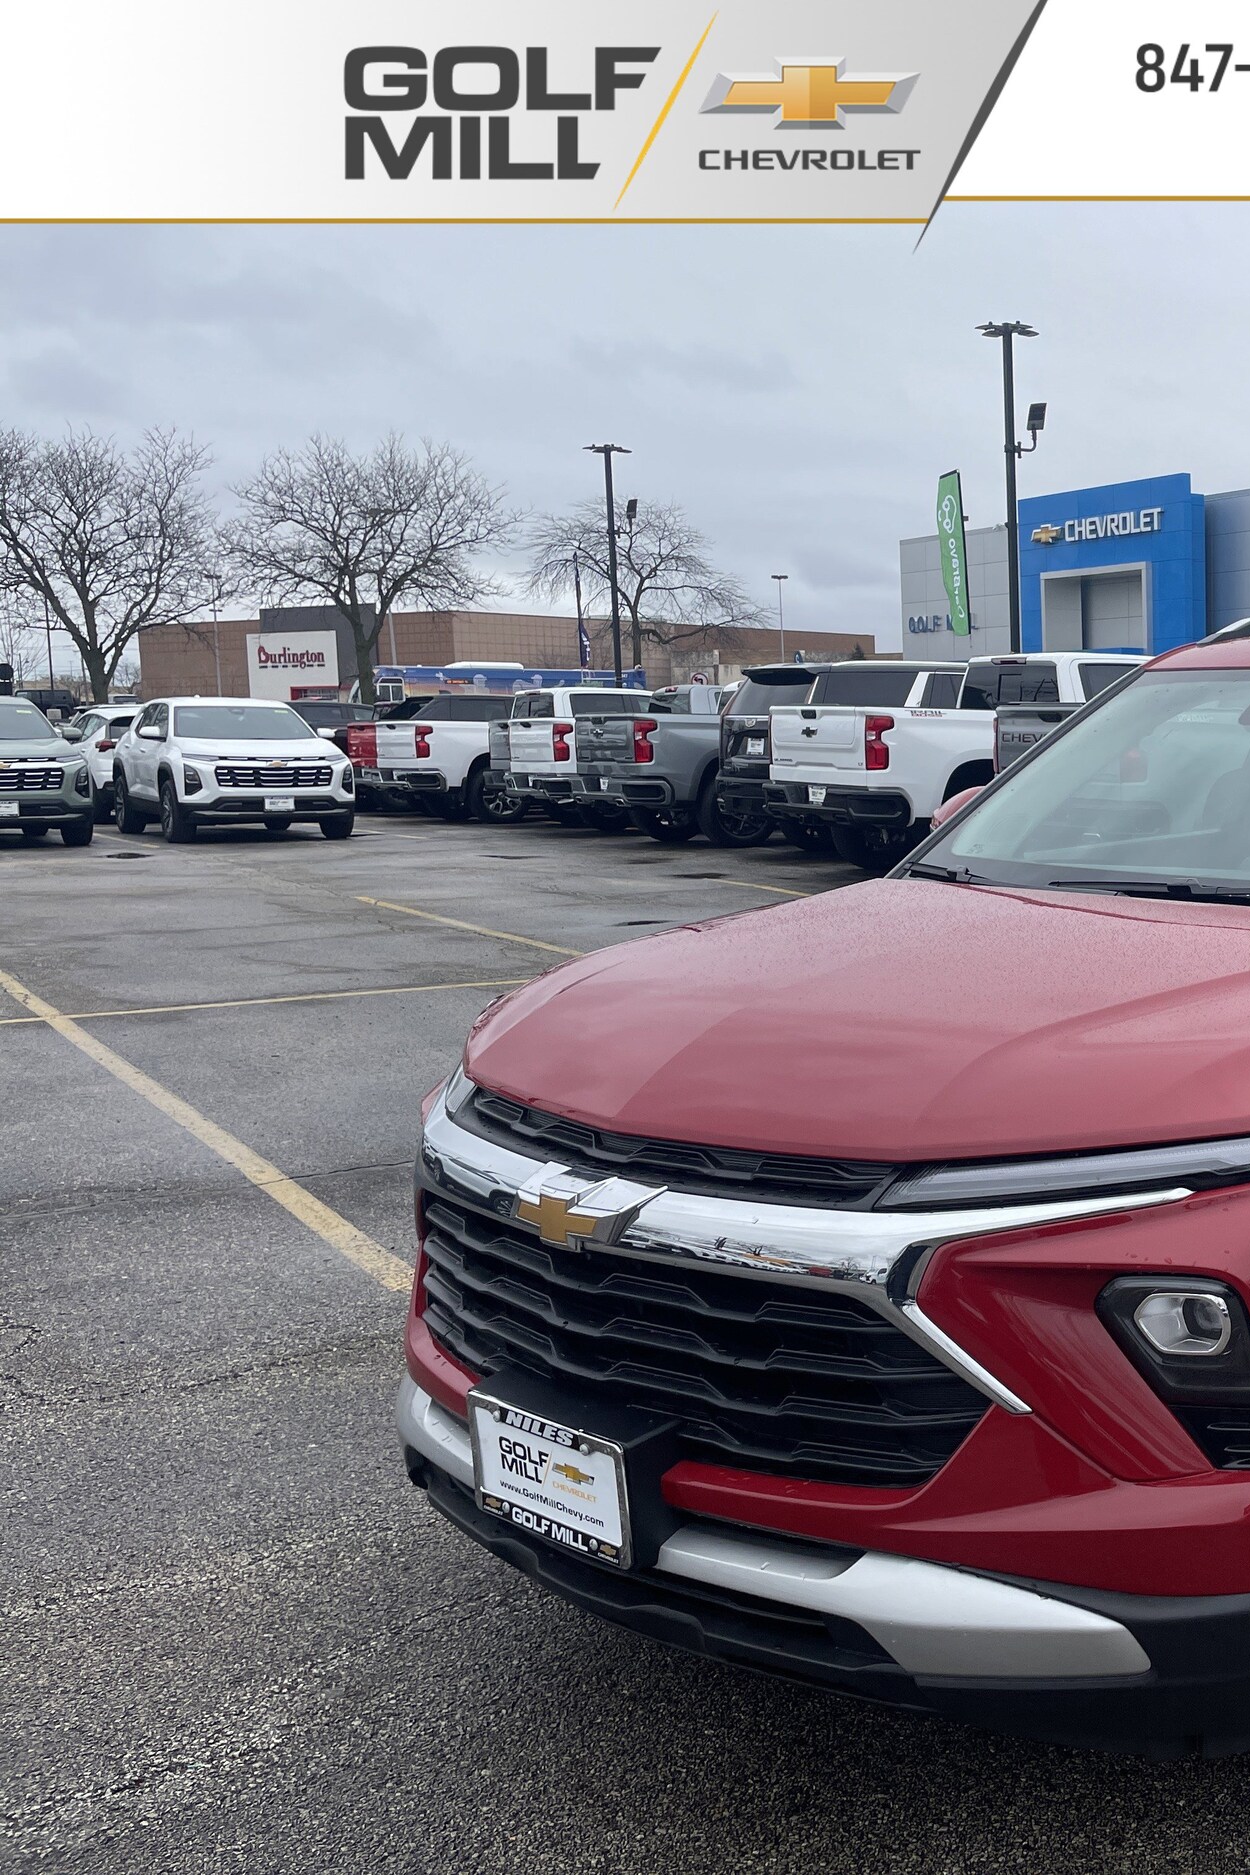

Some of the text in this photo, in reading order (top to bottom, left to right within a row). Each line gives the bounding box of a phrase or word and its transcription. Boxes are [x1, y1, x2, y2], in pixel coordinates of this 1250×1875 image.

[1065, 507, 1163, 542] CHEVROLET
[257, 645, 326, 669] Burlington
[505, 1410, 574, 1447] NILES
[499, 1435, 549, 1468] GOLF
[501, 1452, 542, 1484] MILL
[500, 1480, 604, 1528] www.GolfMillChevy.com
[552, 1481, 598, 1503] CHEVROLET
[512, 1506, 588, 1552] GOLF MILL
